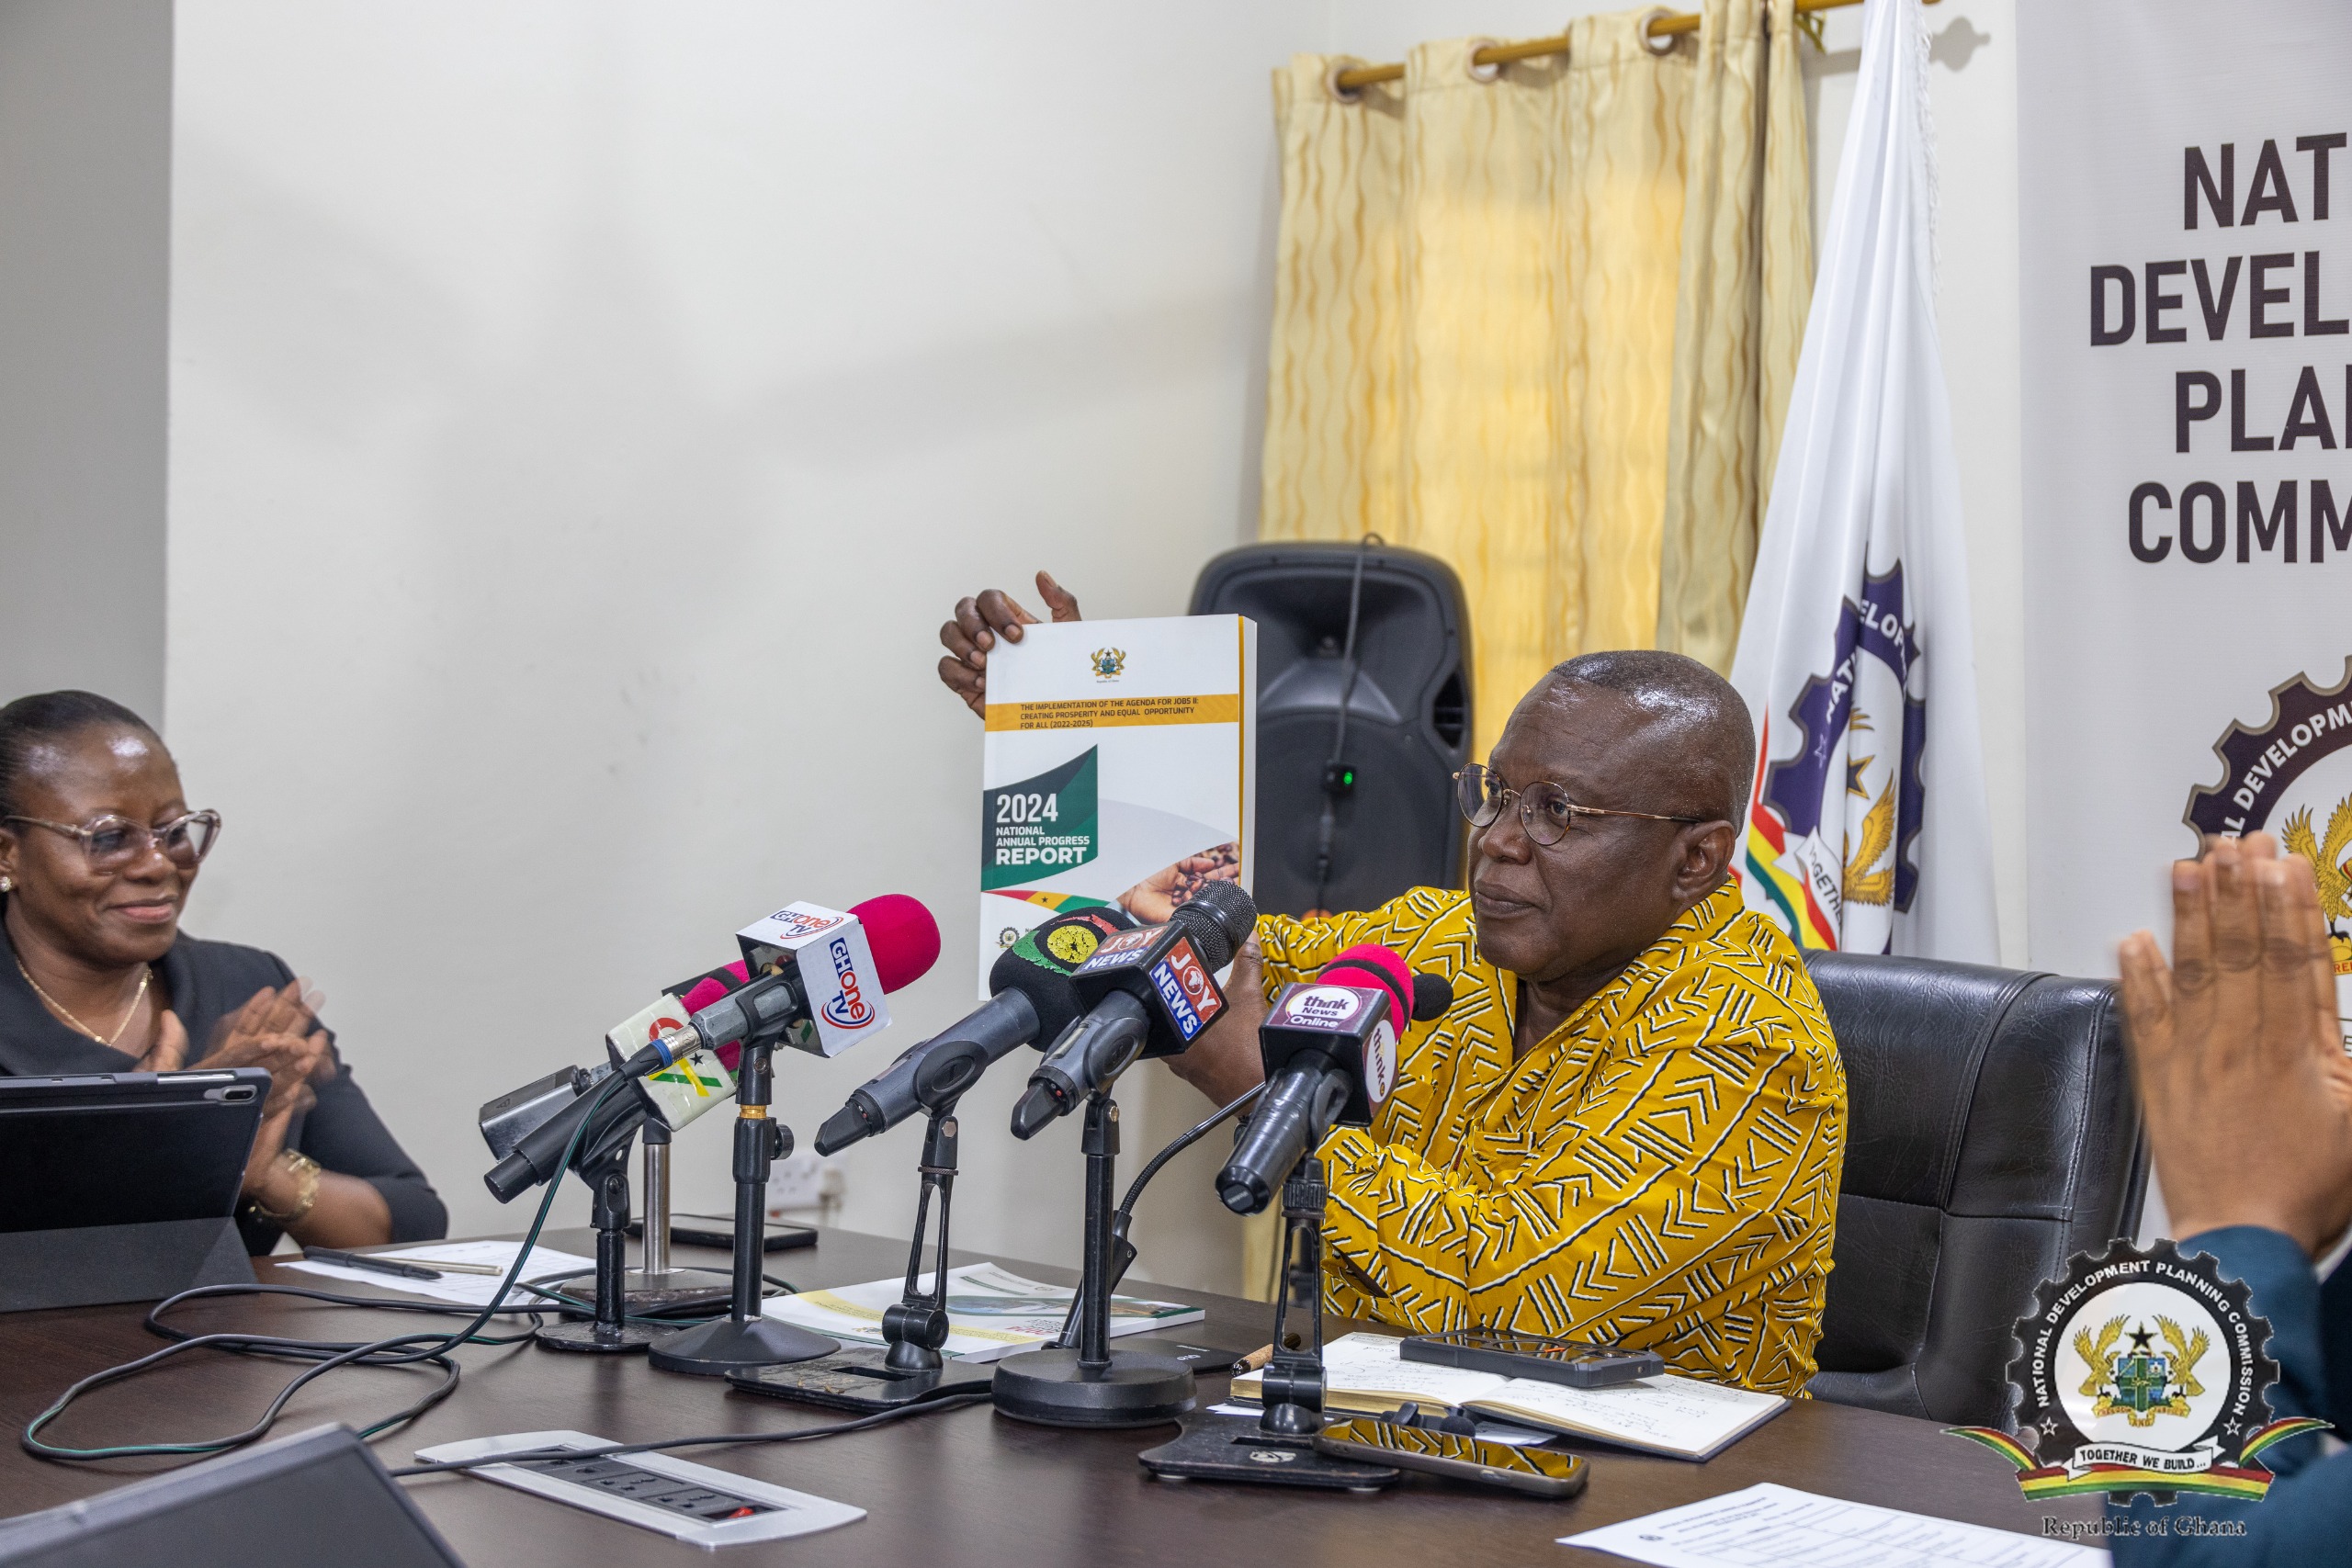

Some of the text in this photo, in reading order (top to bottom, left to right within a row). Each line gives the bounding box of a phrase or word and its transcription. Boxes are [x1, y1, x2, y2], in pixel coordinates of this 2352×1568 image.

[2184, 132, 2347, 231] NAT
[2090, 251, 2350, 347] DEVEL
[2176, 364, 2352, 454] PLA
[1826, 652, 1856, 725] NAT
[1020, 706, 1194, 720] CREATING PROSPERITY AND EQUAL OPPORTUNITY
[1021, 704, 1035, 712] THE
[1035, 701, 1097, 710] IMPLEMENTATION
[1099, 700, 1109, 708] OF
[1111, 699, 1125, 707] THE
[1125, 698, 1156, 707] AGENDA
[1173, 697, 1192, 705] JOBS
[1050, 719, 1093, 729] (2022-2025)
[2233, 701, 2352, 811] DEVELOPM
[996, 793, 1058, 823] 2024
[996, 826, 1045, 836] NATIONAL
[996, 836, 1090, 846] ANNUAL PROGRESS
[996, 846, 1087, 865] REPORT
[790, 924, 812, 934] TV
[1084, 948, 1144, 970] NEWS
[831, 990, 849, 1014] TV
[1154, 964, 1198, 1034] NEWS
[1304, 995, 1350, 1010] think
[1290, 1014, 1339, 1029] Online
[1301, 1007, 1339, 1017] News
[1374, 1028, 1385, 1085] think
